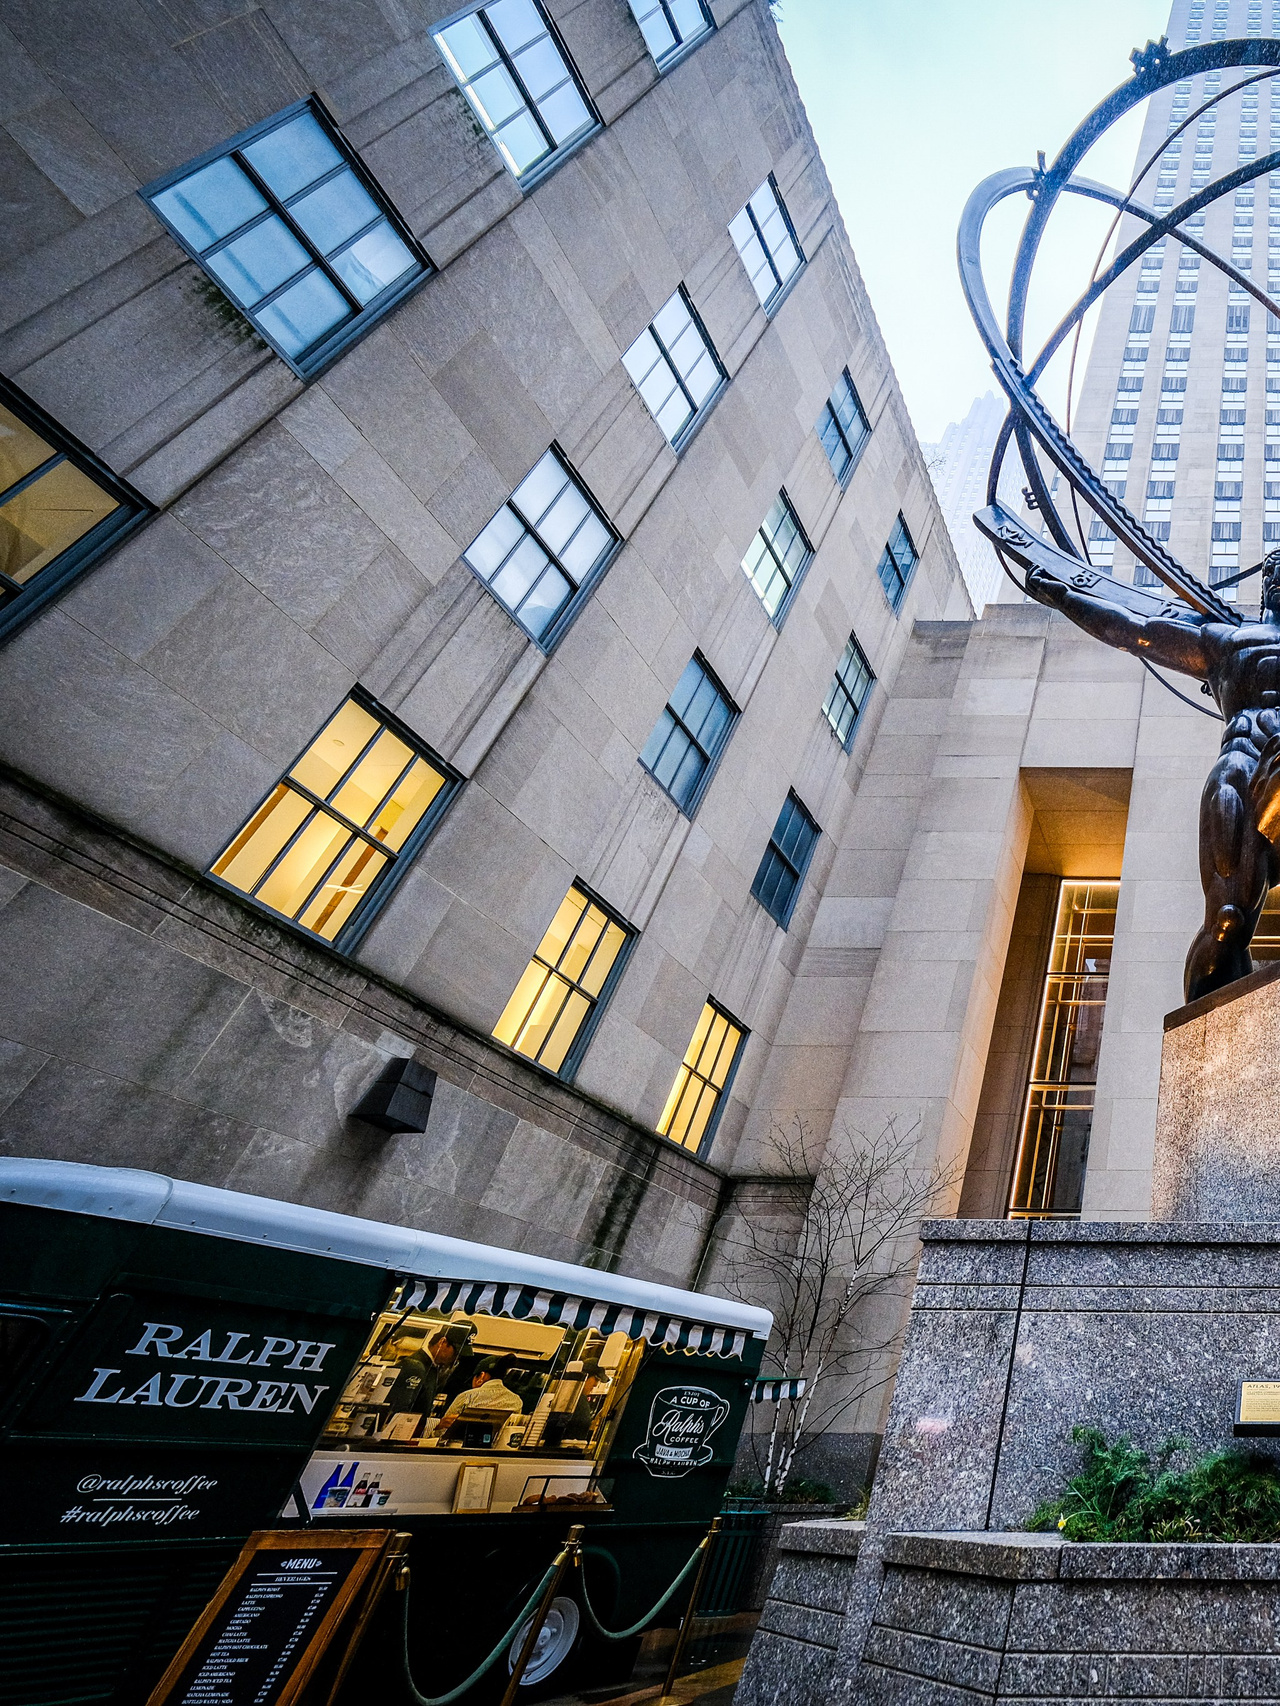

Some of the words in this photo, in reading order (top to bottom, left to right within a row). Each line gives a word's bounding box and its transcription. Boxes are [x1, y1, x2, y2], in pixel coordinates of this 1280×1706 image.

[125, 1322, 336, 1372] RALPH
[74, 1368, 330, 1415] LAUREN
[670, 1396, 677, 1404] A
[680, 1396, 698, 1405] CUP
[700, 1400, 710, 1408] OF
[652, 1410, 705, 1446] Ralph's
[670, 1436, 700, 1444] COFFEE
[657, 1447, 669, 1456] JAVA
[77, 1474, 218, 1495] @ralphscoffee
[60, 1505, 200, 1527] #ralphscoffee
[285, 1558, 317, 1569] MENU
